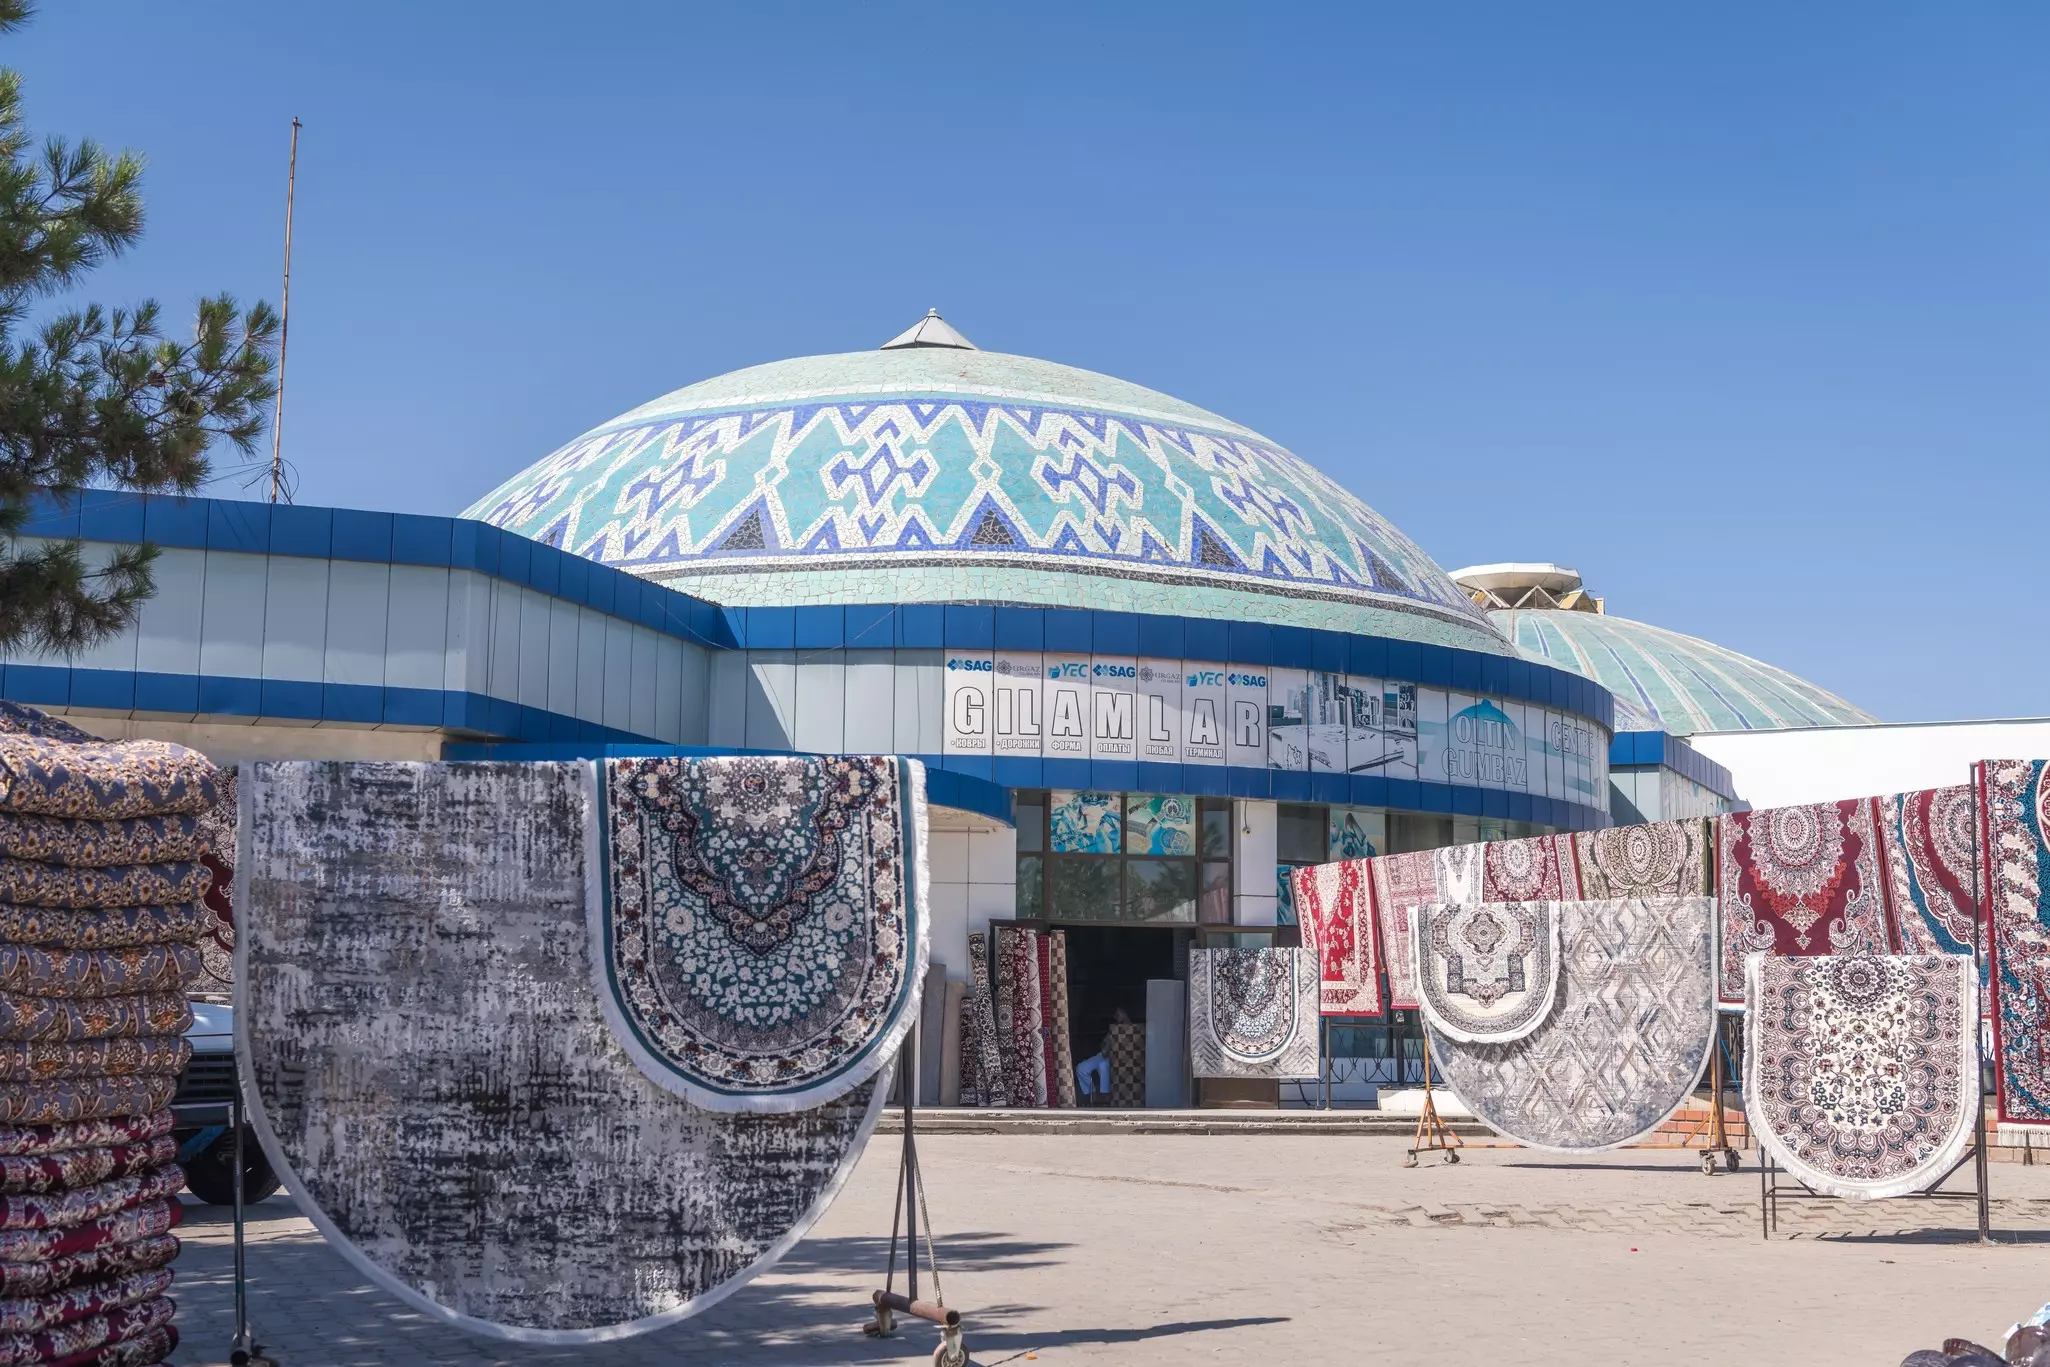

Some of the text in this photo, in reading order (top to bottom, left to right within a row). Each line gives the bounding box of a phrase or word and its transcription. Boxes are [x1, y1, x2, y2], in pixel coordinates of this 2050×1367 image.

[964, 660, 1266, 687] SAG URGAZ YEC SAG URGAZ YEC SAG
[953, 687, 1260, 747] GILAMLAR
[1455, 715, 1516, 750] OLTIN
[956, 738, 1223, 759] КОВРЫ ДОРОЖКИ ФОРМА ОПЛАТЫ ЛЮБАЯ ТЕРМИНАЛ
[1551, 721, 1595, 761] CENTRE
[1441, 748, 1527, 787] GUMBAZ
